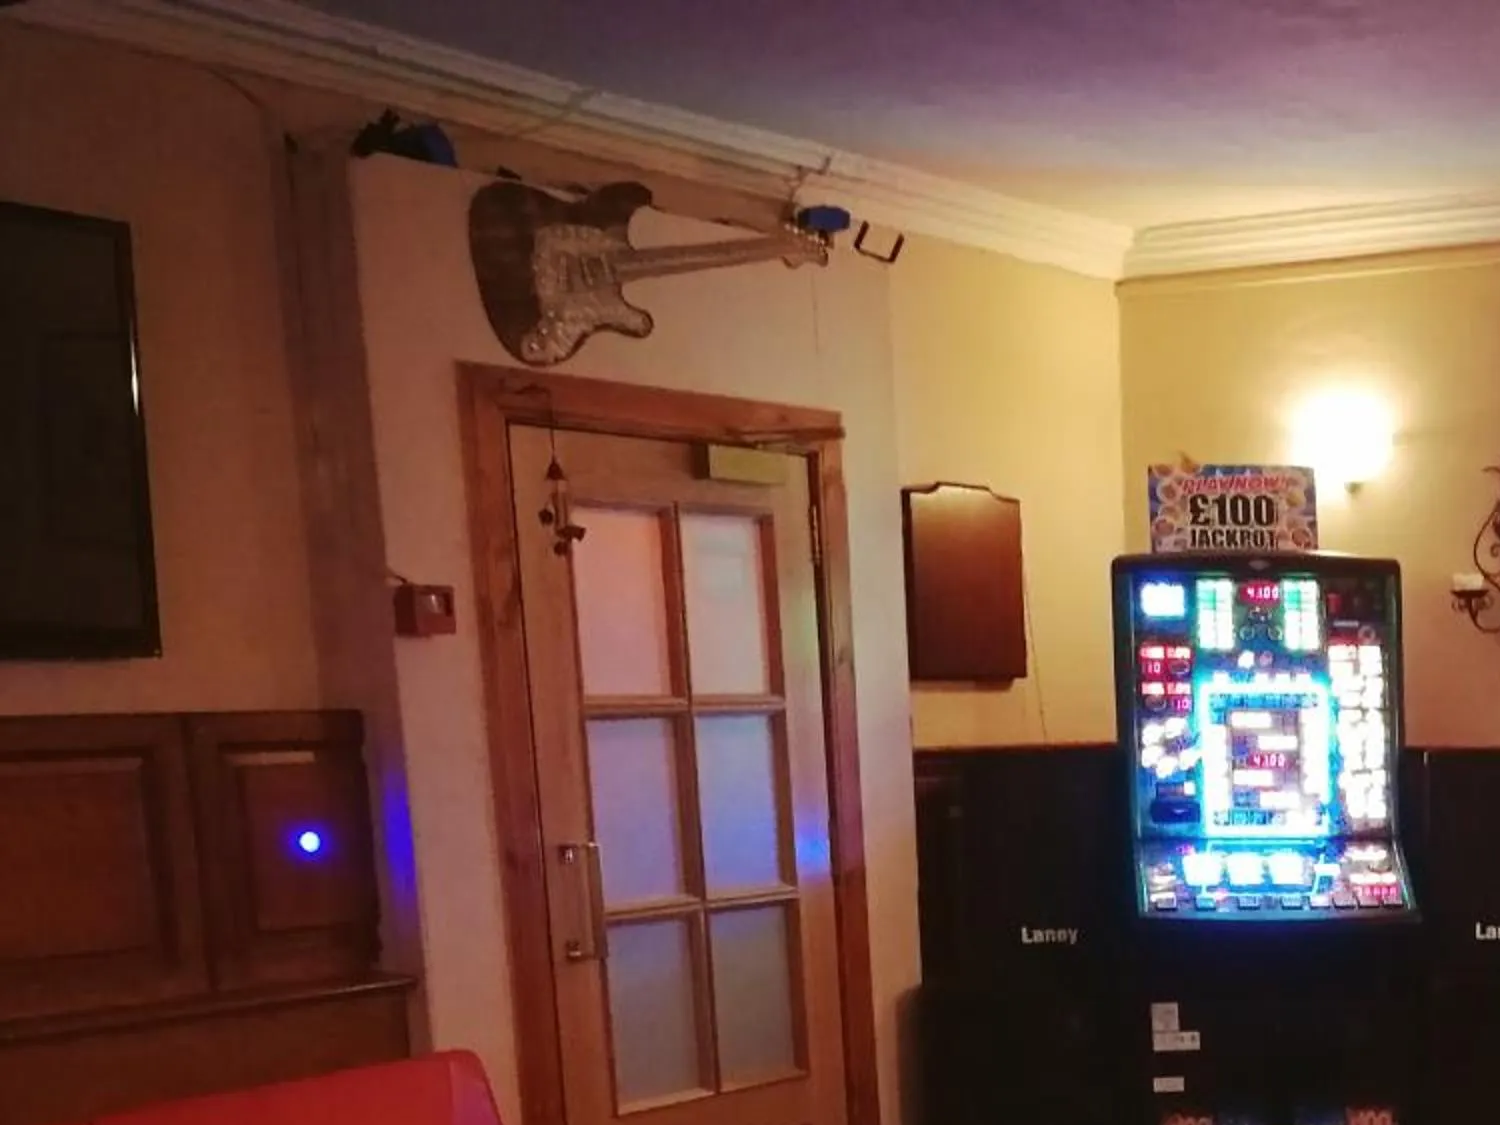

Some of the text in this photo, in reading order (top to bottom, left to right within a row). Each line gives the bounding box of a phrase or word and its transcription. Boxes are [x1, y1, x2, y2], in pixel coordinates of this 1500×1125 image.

[1189, 493, 1275, 526] £100
[1190, 528, 1276, 549] JACKPOT
[1021, 926, 1079, 945] Laney
